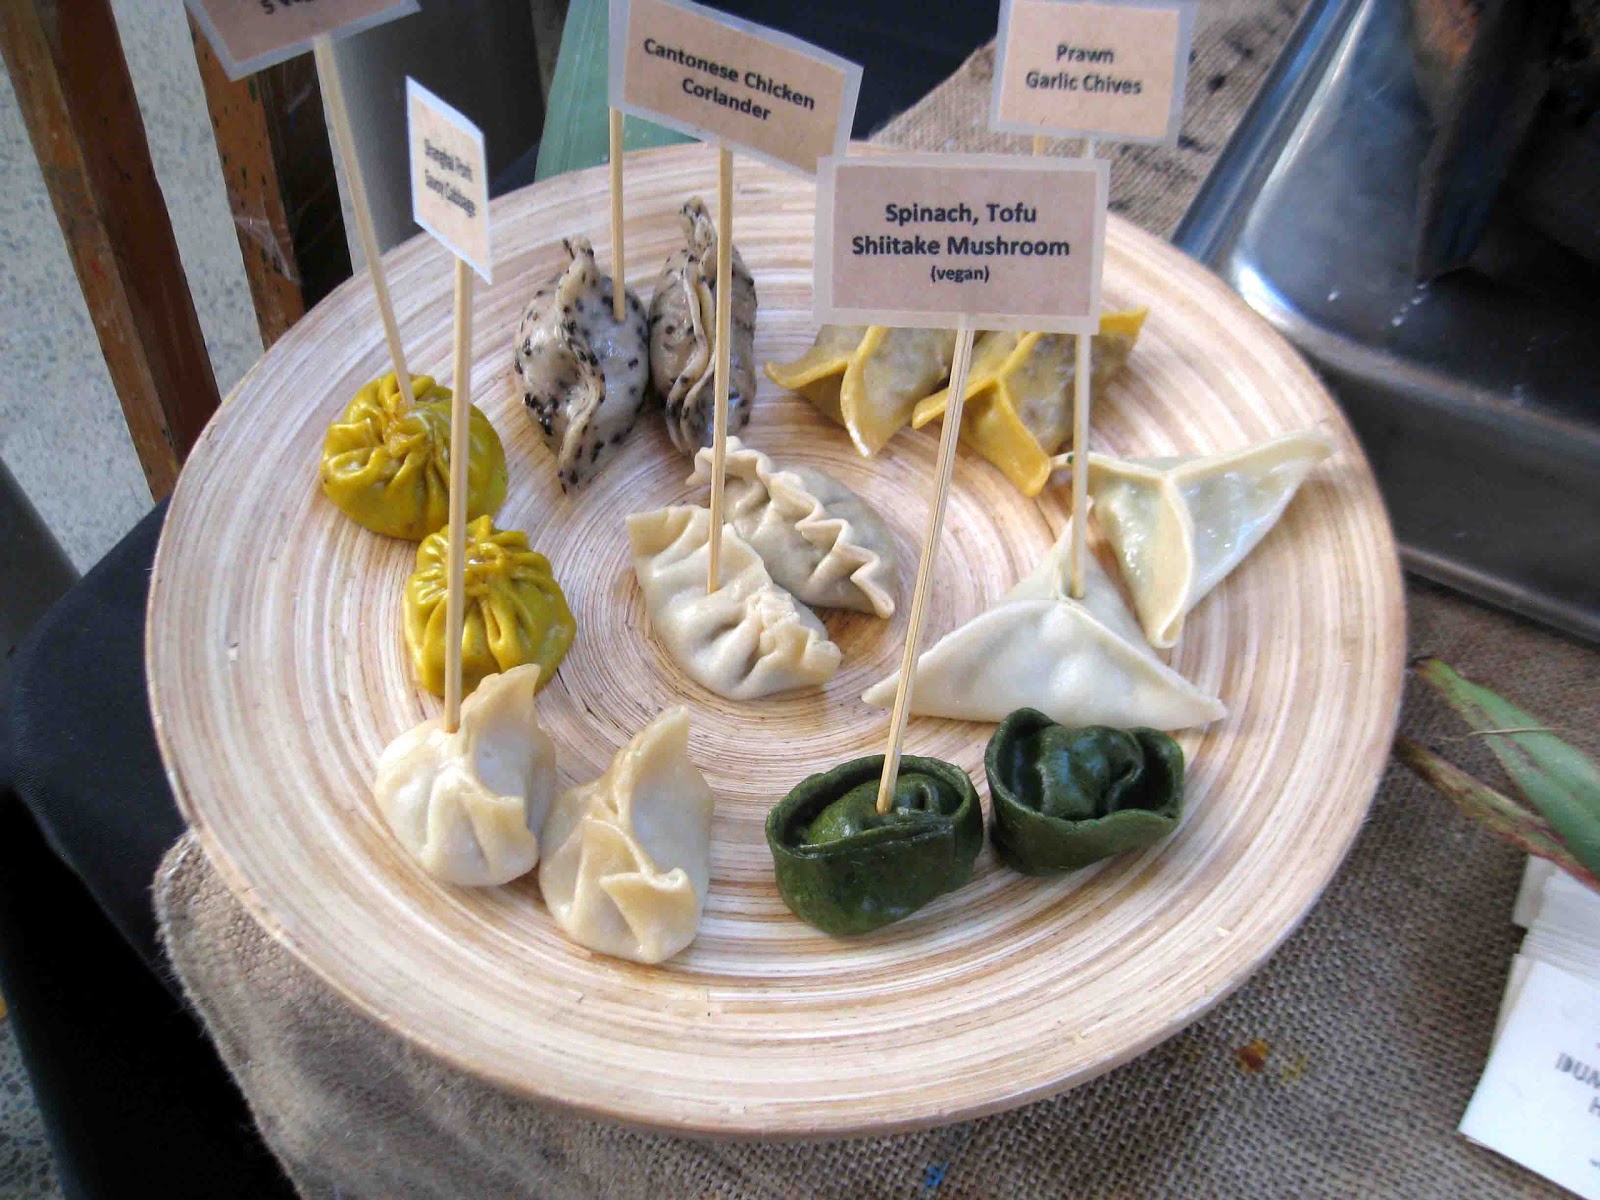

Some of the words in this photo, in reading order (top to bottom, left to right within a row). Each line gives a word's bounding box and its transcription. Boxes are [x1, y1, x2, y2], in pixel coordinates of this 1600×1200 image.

[1056, 43, 1115, 63] Prawn
[643, 38, 739, 83] Cantonese
[744, 71, 815, 111] Chicken
[1025, 71, 1078, 91] Garlic
[1082, 74, 1142, 95] Chives
[682, 77, 772, 121] Coriander
[885, 203, 979, 227] Spinach,
[986, 203, 1037, 223] Tofu
[852, 235, 941, 256] Shiitake
[947, 236, 1070, 256] Mushroom
[930, 265, 990, 283] (vegan)
